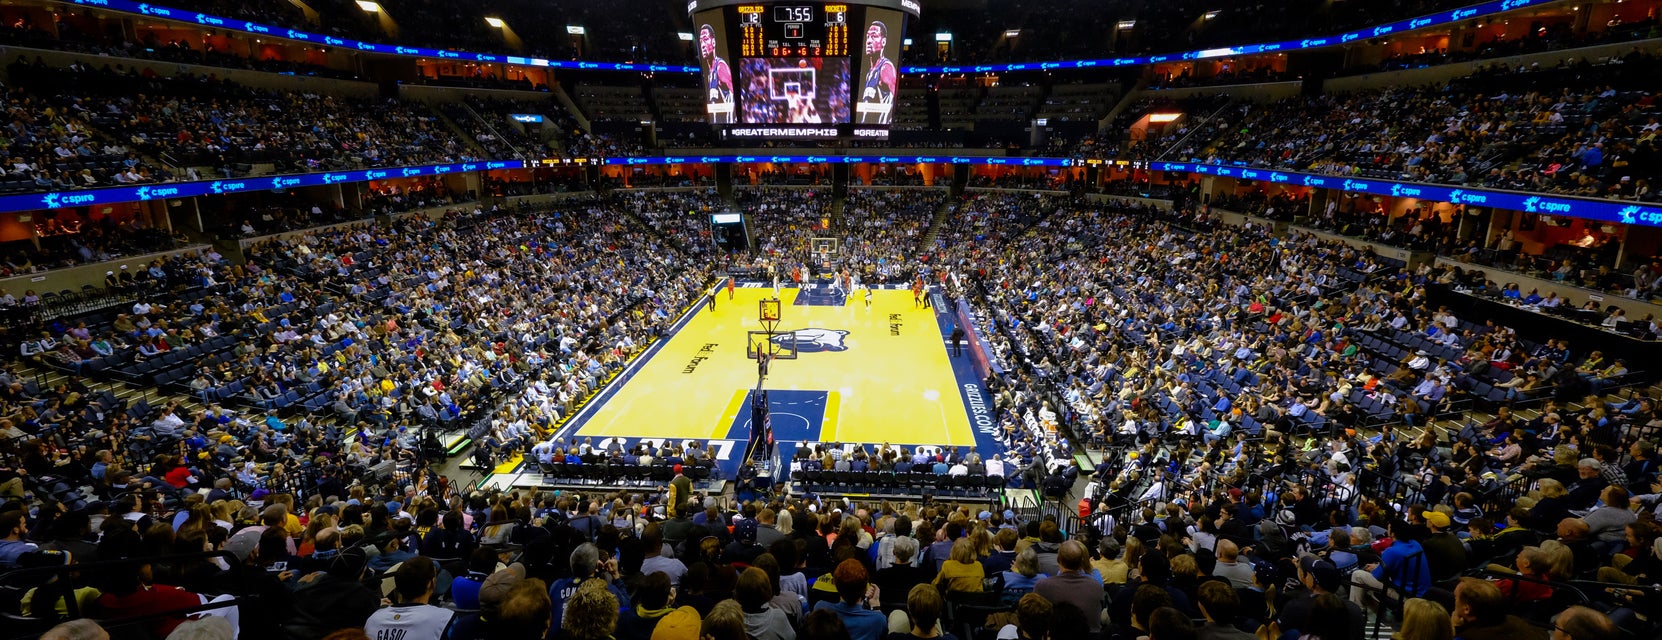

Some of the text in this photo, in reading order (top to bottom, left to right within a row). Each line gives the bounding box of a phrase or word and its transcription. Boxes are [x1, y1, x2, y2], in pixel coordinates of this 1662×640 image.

[750, 13, 758, 22] 12
[786, 8, 810, 21] 7:55
[837, 12, 843, 22] 6
[732, 128, 838, 136] #GREATERMEMPHIS
